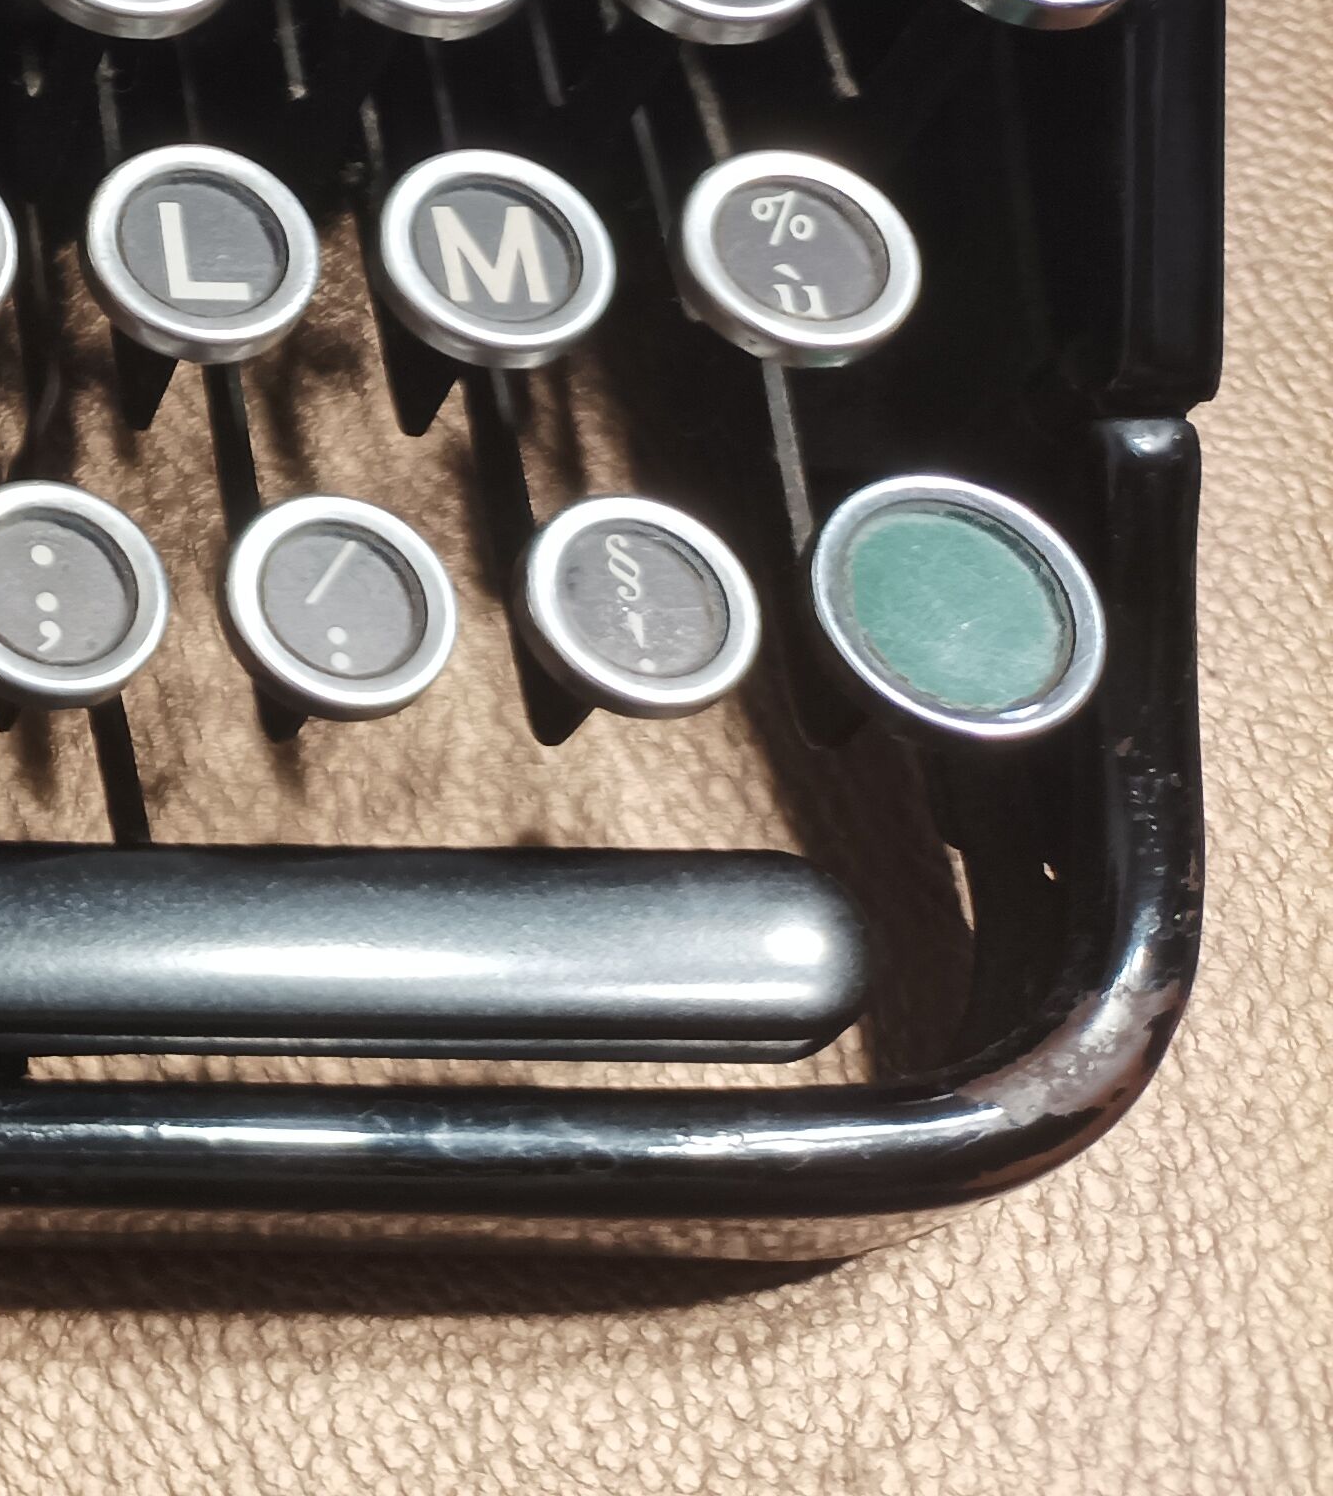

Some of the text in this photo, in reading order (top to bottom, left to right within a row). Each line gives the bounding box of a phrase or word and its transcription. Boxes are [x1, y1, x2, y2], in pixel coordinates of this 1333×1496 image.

[158, 202, 254, 300] L
[751, 190, 816, 246] %
[431, 206, 550, 303] M
[306, 541, 357, 604] /
[605, 534, 641, 602] §
